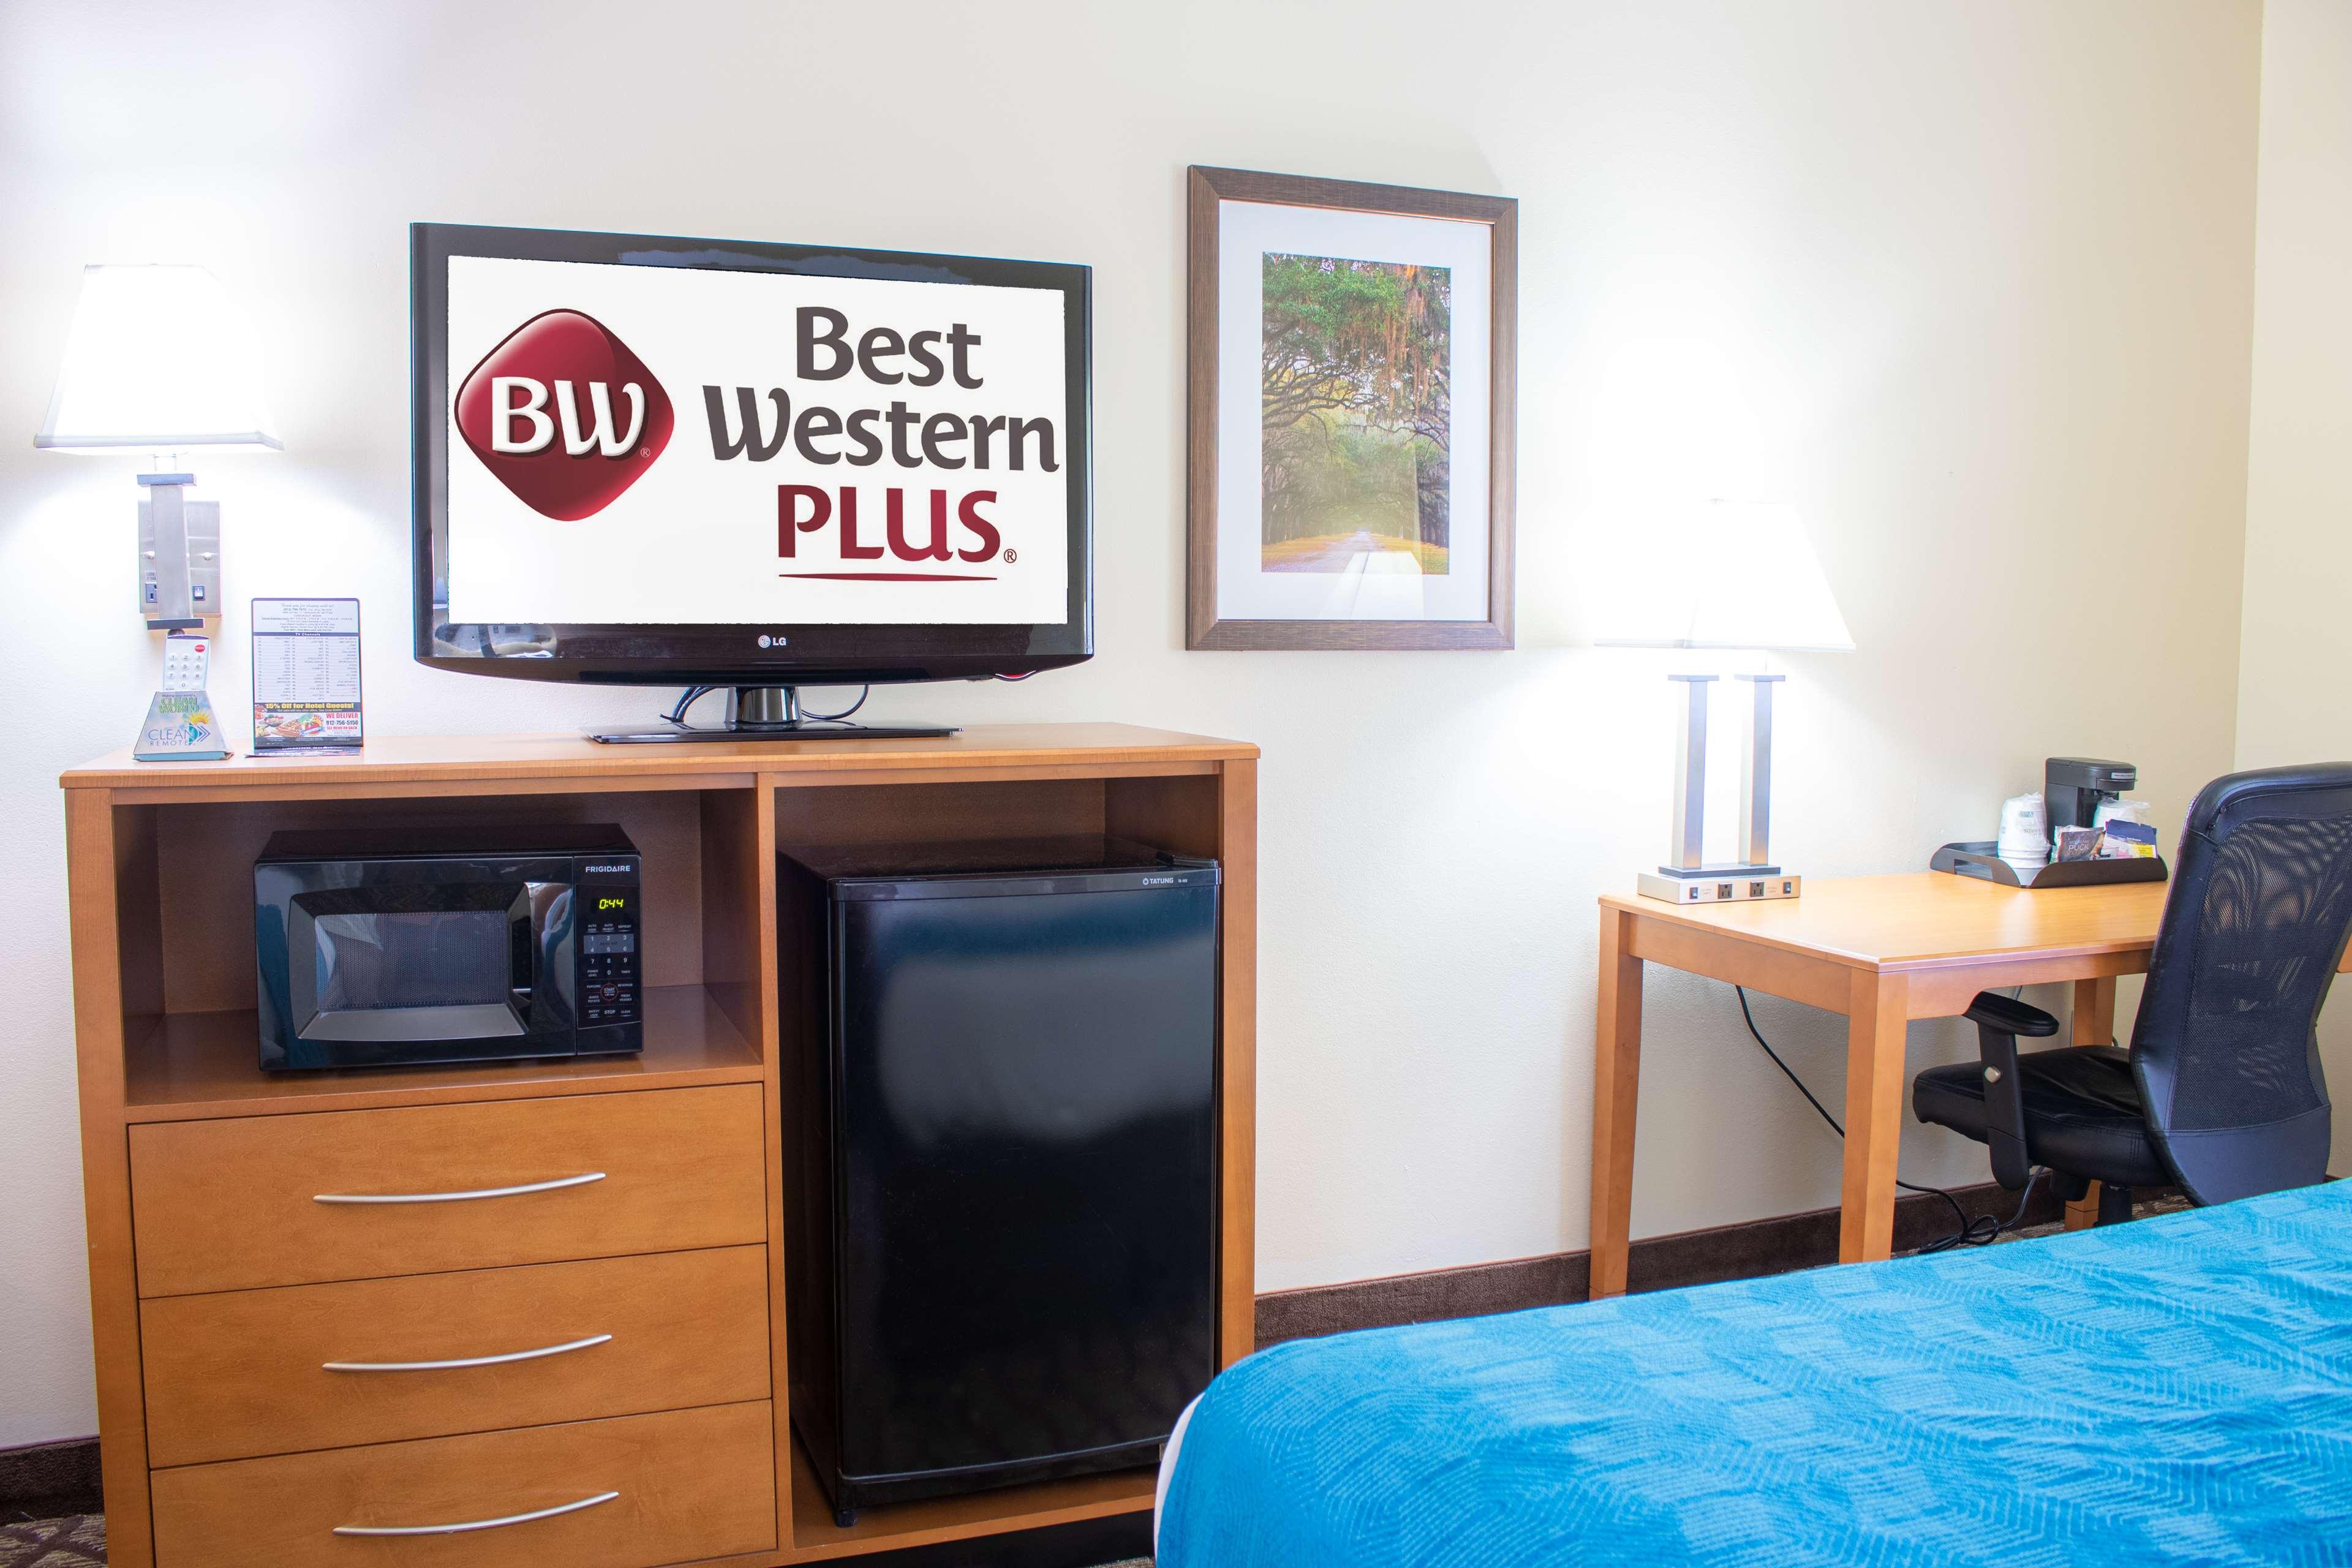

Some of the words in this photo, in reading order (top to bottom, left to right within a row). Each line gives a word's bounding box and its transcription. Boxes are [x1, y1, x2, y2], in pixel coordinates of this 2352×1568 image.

[796, 306, 983, 390] Best
[492, 376, 644, 456] BW
[703, 385, 1060, 473] Western
[772, 637, 786, 646] LG
[159, 704, 200, 714] WORLD
[148, 728, 197, 741] CLEAN
[599, 899, 624, 910] 0:44
